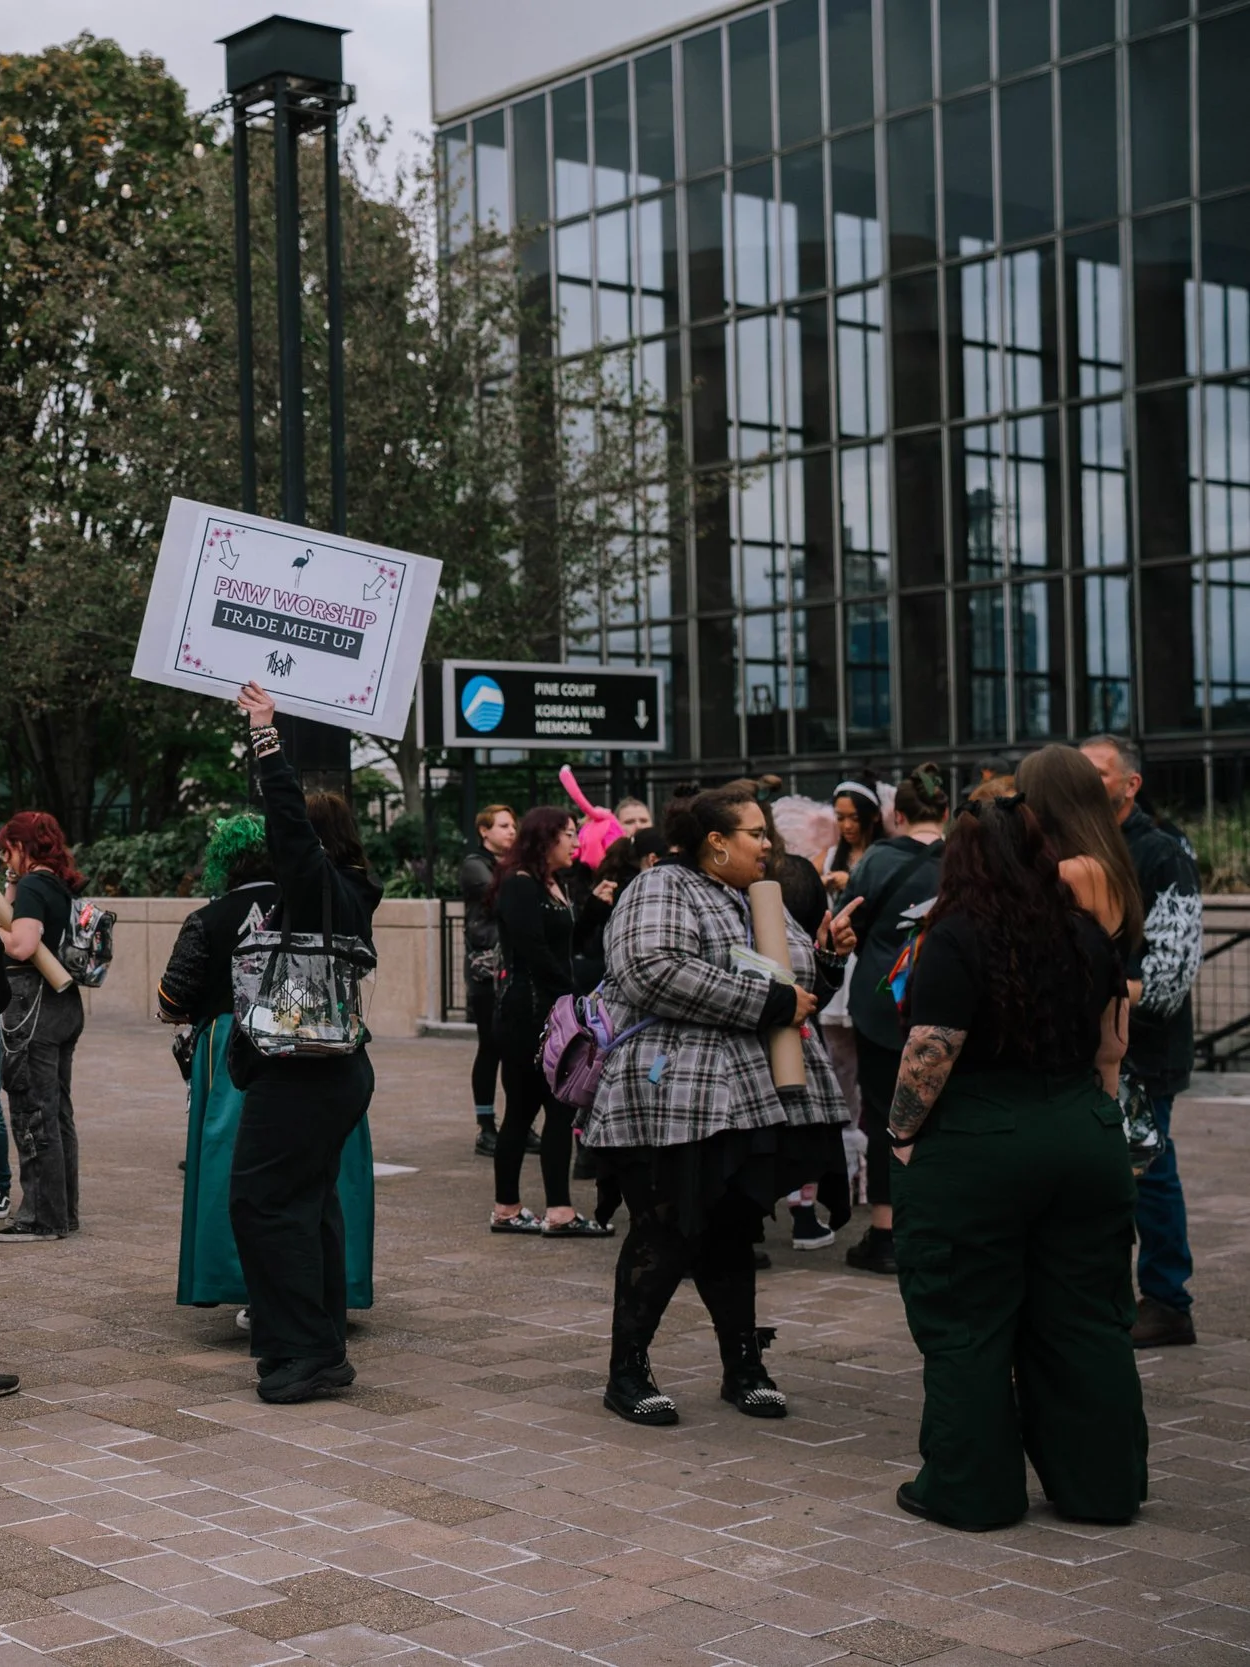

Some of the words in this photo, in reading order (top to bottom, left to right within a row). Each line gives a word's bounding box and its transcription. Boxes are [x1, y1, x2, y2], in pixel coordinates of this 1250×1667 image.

[214, 576, 271, 605] PNW
[273, 589, 377, 630] WORSHIP
[222, 607, 278, 633] TRADE
[281, 621, 330, 645] MEET
[332, 633, 356, 650] UP
[560, 682, 597, 697] COURT
[534, 704, 580, 718] KOREAN
[580, 705, 606, 719] WAR
[535, 720, 592, 735] MEMORIAL
